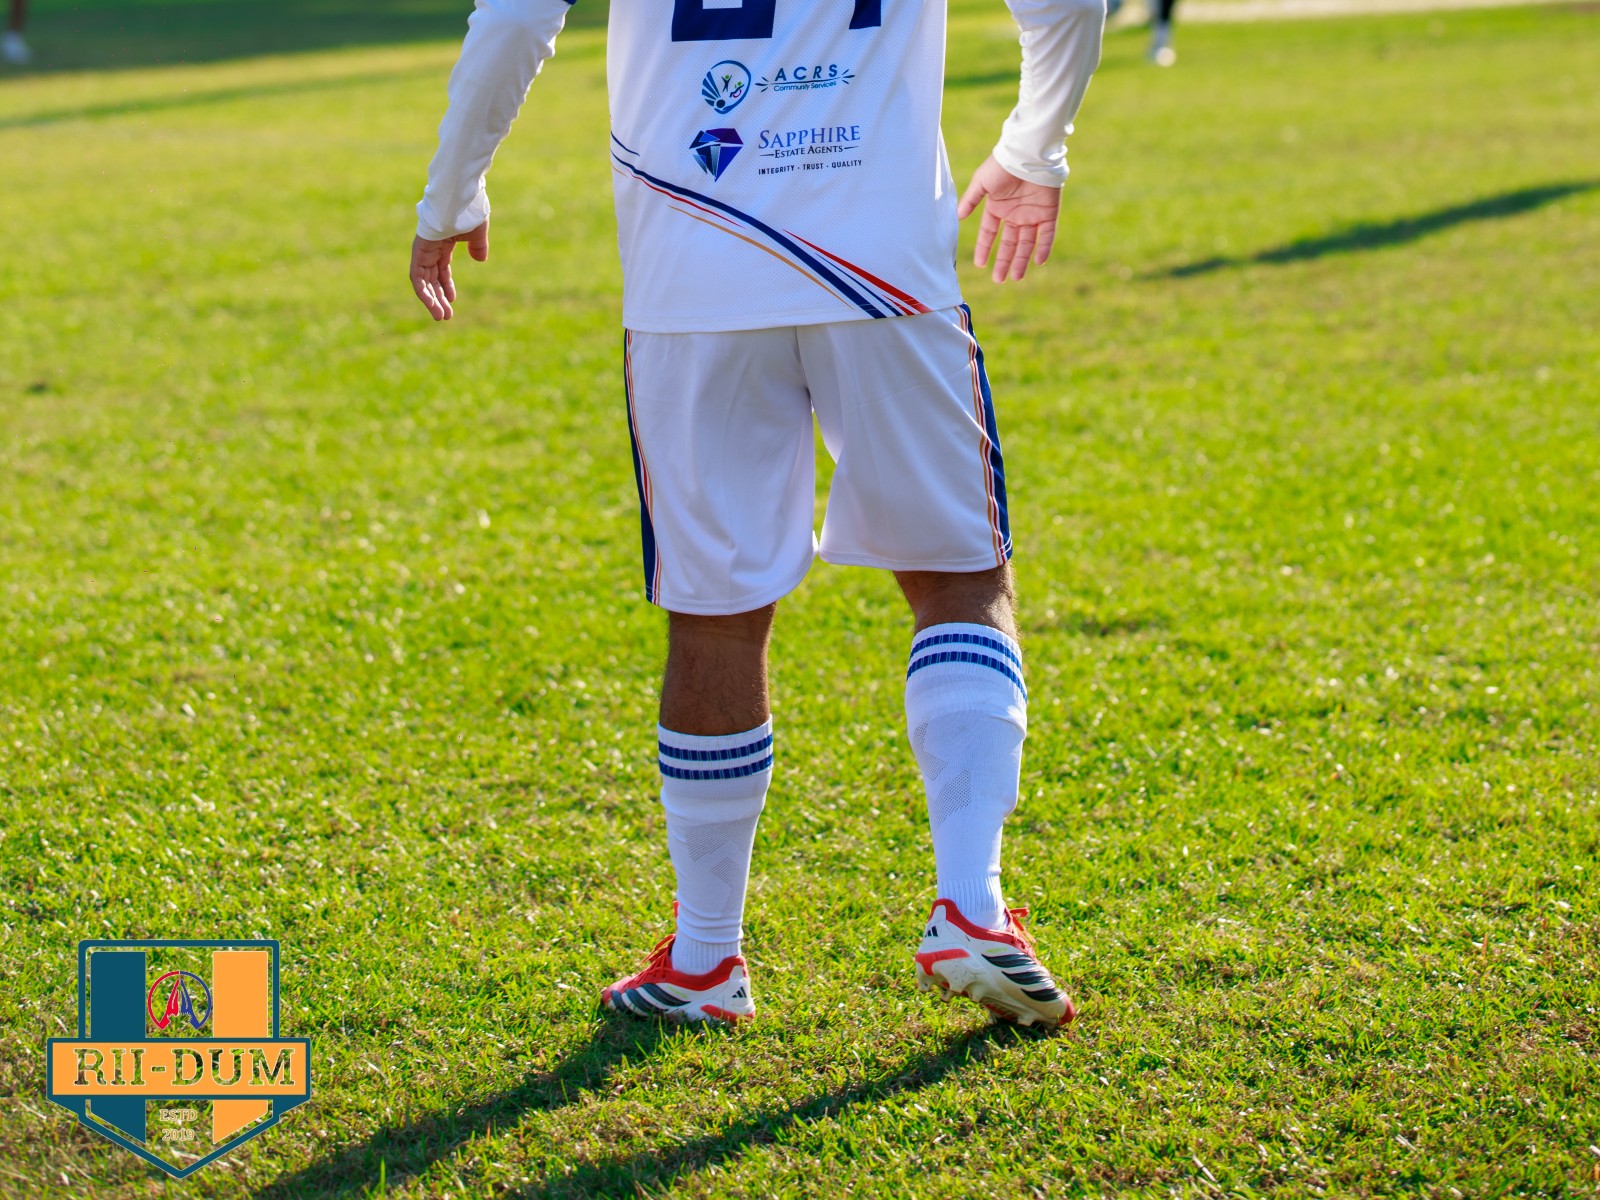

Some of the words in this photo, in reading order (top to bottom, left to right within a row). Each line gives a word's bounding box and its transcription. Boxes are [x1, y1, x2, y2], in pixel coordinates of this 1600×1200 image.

[775, 64, 838, 81] ACRS
[773, 83, 811, 92] Community
[811, 81, 837, 89] Services
[758, 125, 861, 150] SAPPHIRE
[774, 147, 806, 159] ESTATE
[807, 145, 843, 155] AGENTS
[758, 164, 795, 175] INTEGRITY
[803, 162, 824, 171] TRUST
[831, 159, 863, 169] QUALITY
